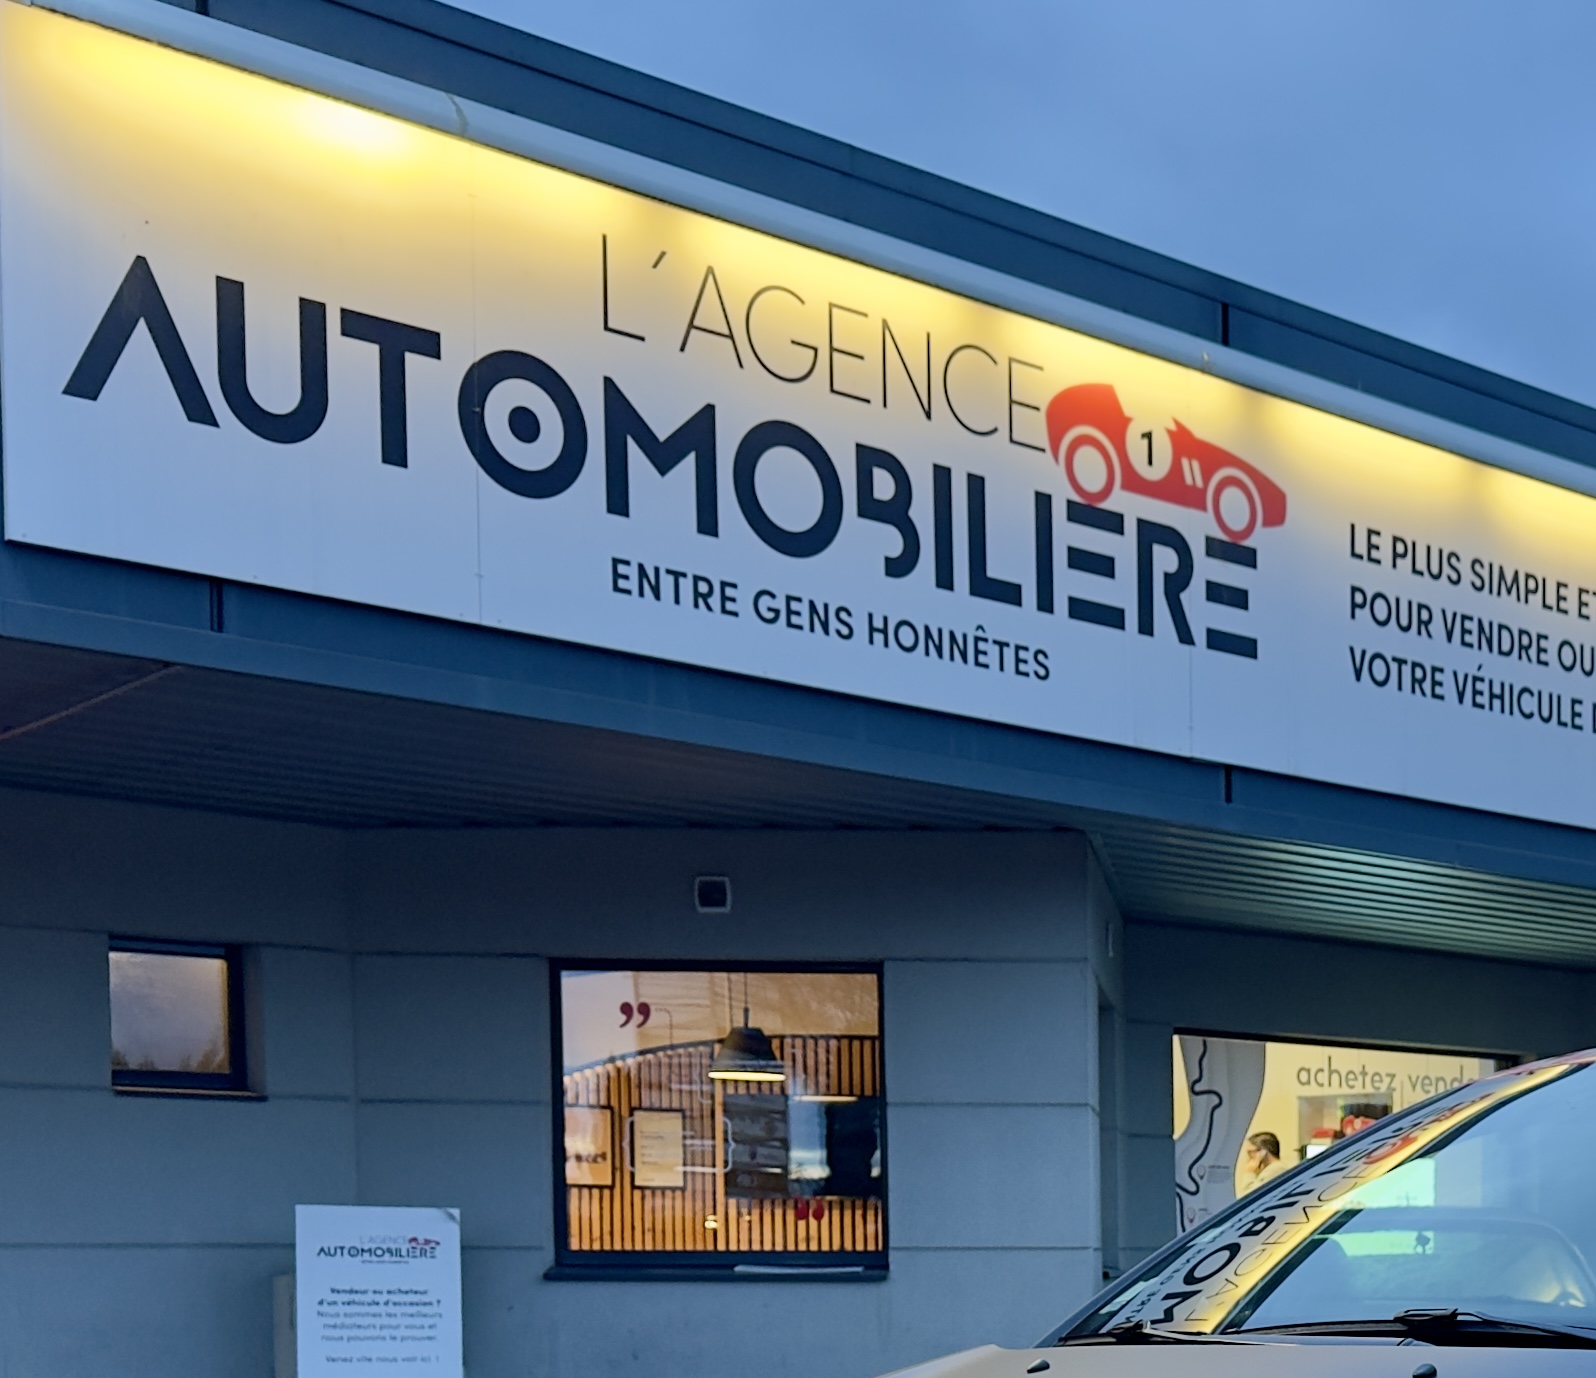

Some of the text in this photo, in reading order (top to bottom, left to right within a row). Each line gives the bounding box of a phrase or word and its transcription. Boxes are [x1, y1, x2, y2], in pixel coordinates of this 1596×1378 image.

[601, 232, 1048, 454] L'AGENCE
[1350, 523, 1381, 565] LE
[1392, 534, 1461, 586] PLUS
[1470, 562, 1570, 613] SIMPLE
[610, 556, 1051, 682] ENTRE GENS HONNÊTES
[1349, 585, 1434, 639] POUR
[1441, 608, 1550, 666] VENDRE
[1557, 639, 1596, 678] OU
[1349, 646, 1446, 702] VOTRE
[1453, 663, 1584, 731] VÉHICULE
[1296, 1055, 1476, 1094] achetez vend
